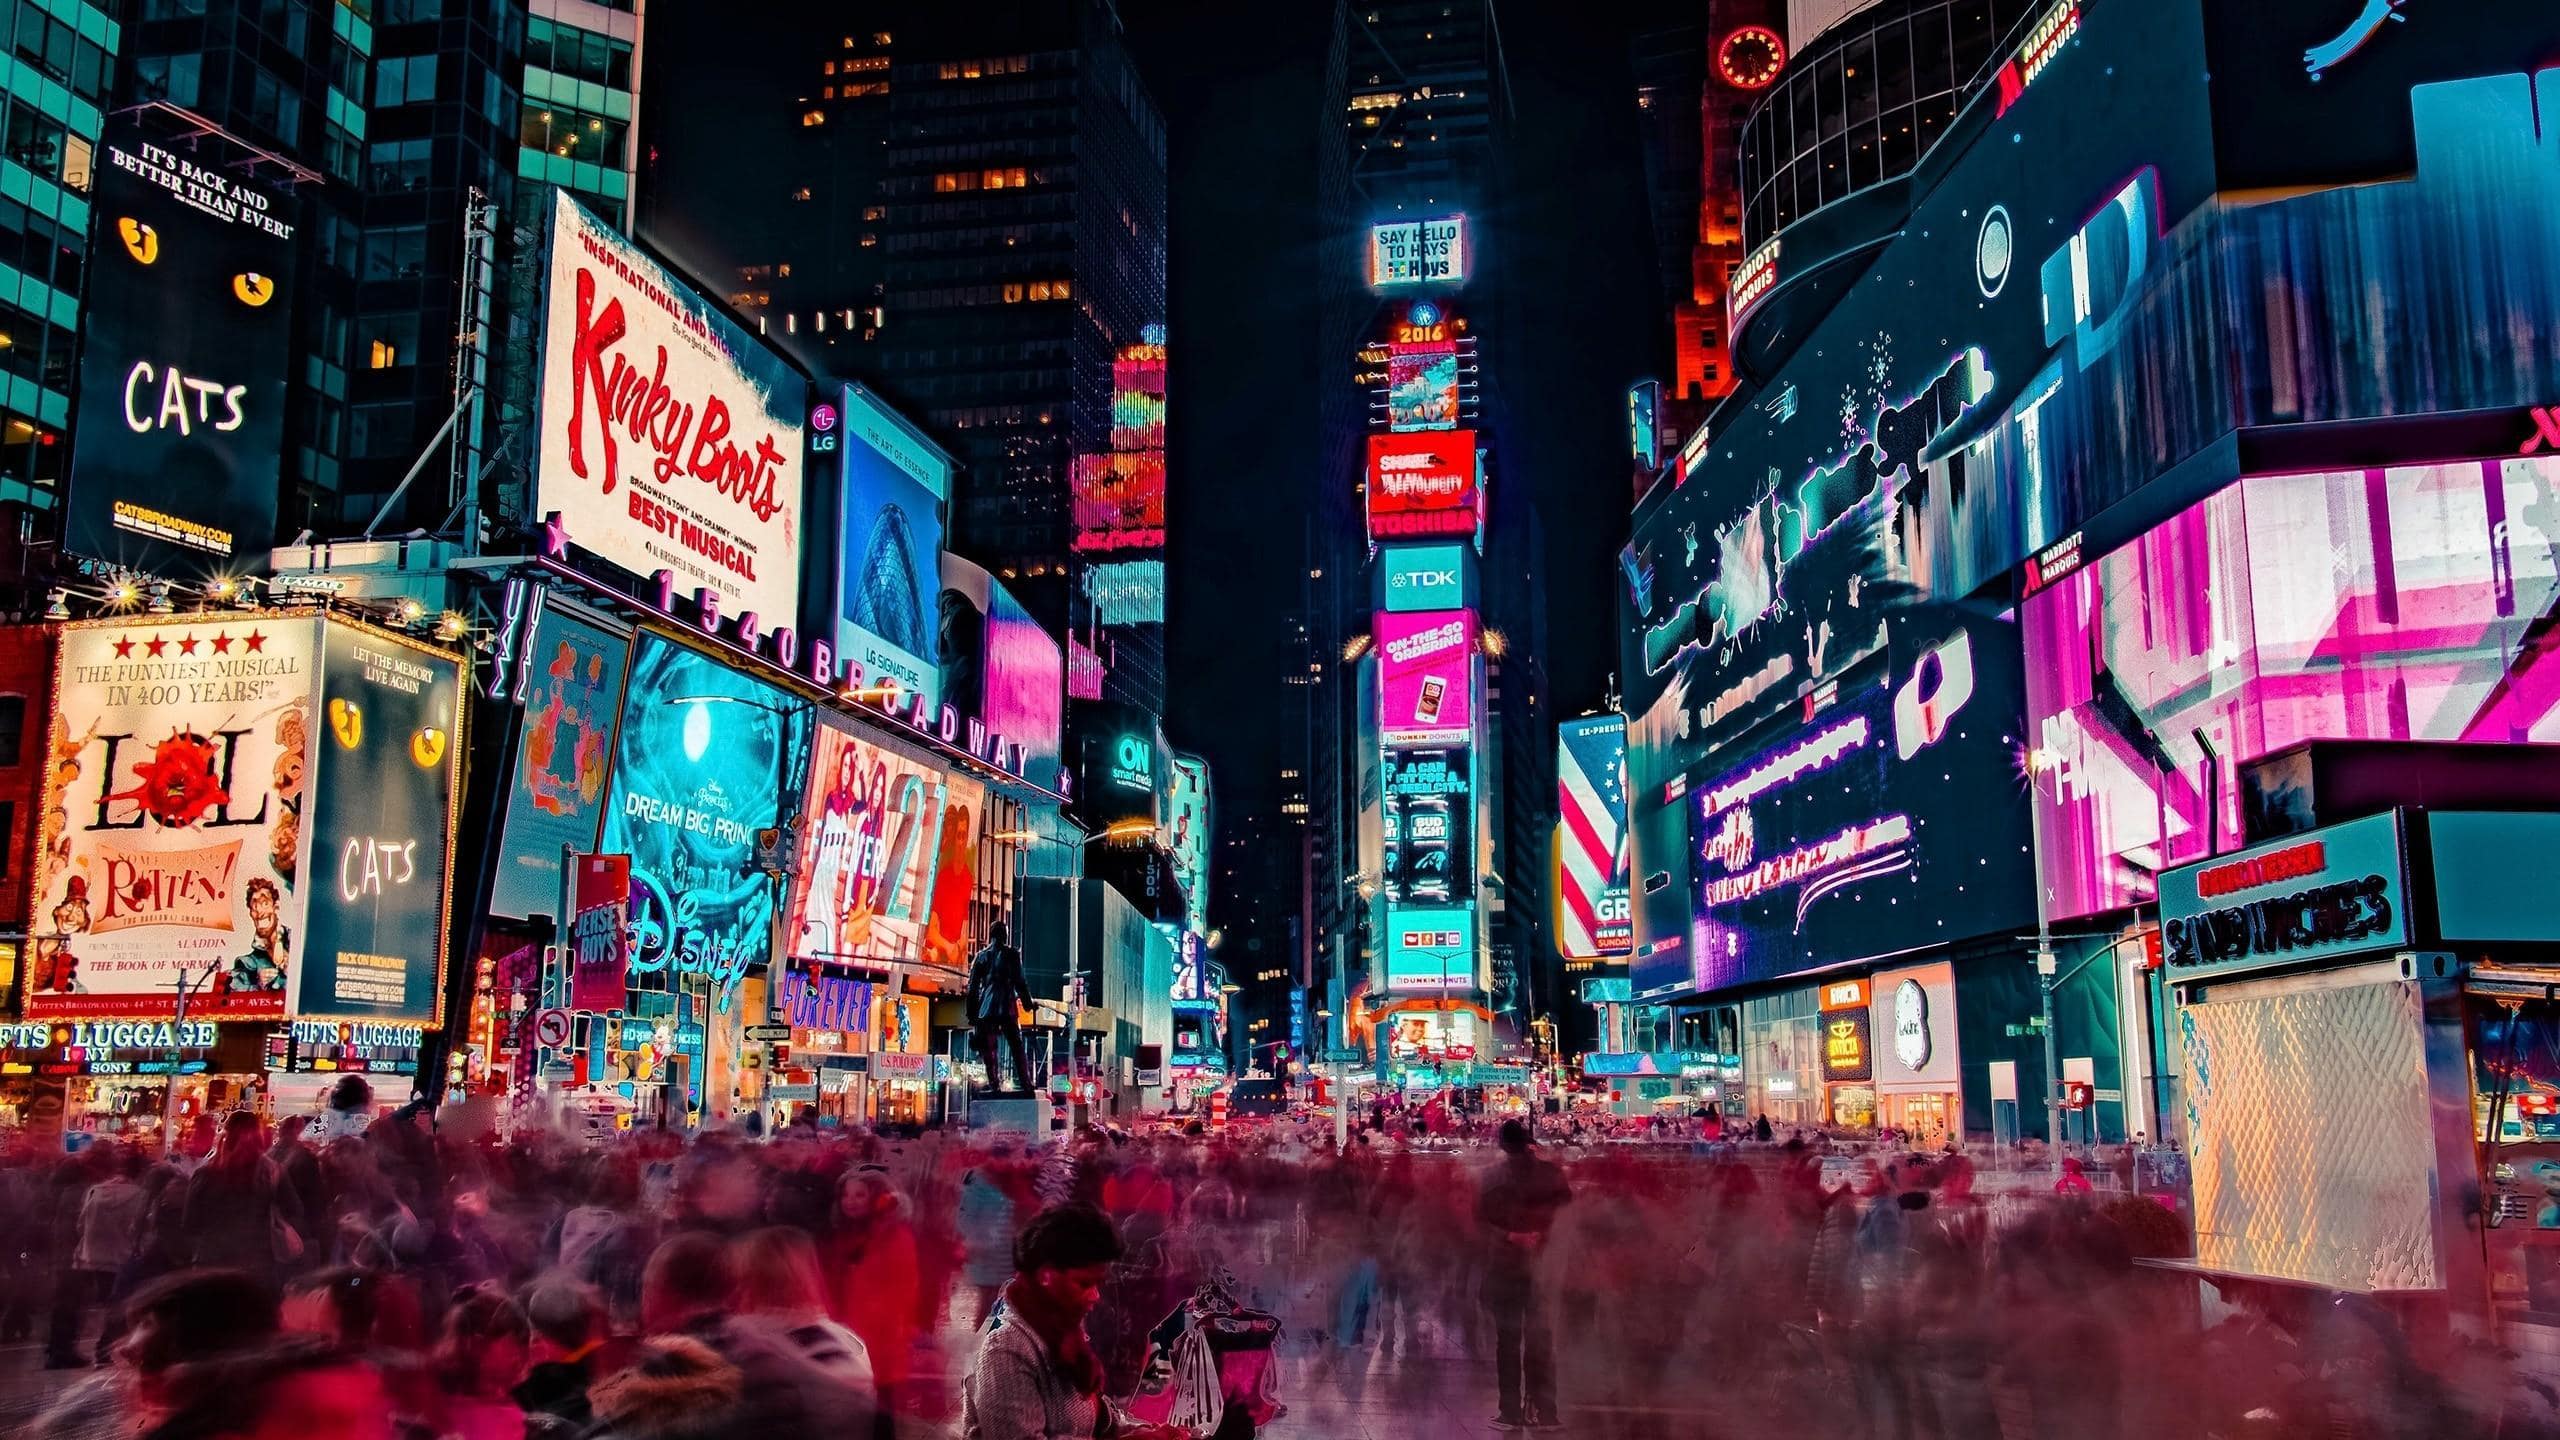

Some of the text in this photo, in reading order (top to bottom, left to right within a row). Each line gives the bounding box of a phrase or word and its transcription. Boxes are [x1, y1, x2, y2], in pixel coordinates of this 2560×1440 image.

[2025, 15, 2077, 87] MARQUIS
[142, 143, 268, 211] IT'S BACK AND
[187, 181, 237, 217] THAN
[1380, 226, 1456, 245] SAY HELLO
[1387, 242, 1448, 258] TO HAYS
[1733, 240, 1780, 297] MARRIOTT
[1734, 268, 1773, 317] MARQUIS
[683, 311, 707, 338] AND
[1400, 326, 1444, 343] 2016
[1390, 342, 1455, 355] TOSHIBA
[125, 362, 247, 436] CATS
[568, 268, 786, 523] Kinky Boots
[813, 436, 834, 451] LG
[867, 427, 930, 483] THE ART OF ESSENCE
[114, 501, 232, 544] CATSBROADWAY.COM
[672, 500, 689, 515] TONY
[691, 511, 703, 523] AND
[1373, 510, 1475, 534] TOSHIBA
[629, 490, 756, 582] BEST MUSICAL
[2041, 531, 2083, 566] MARRIOTT
[1406, 570, 1456, 586] TDK
[2042, 551, 2079, 581] MARQUIS
[1386, 621, 1464, 653] ON-THE-GO
[1392, 632, 1464, 663] ORDERING
[76, 657, 300, 683] THE FUNNIEST MUSICAL
[353, 647, 434, 683] LET THE MEMORY
[650, 568, 1030, 777] 1540 BROADWAY
[866, 647, 919, 688] LG SIGNATURE
[366, 667, 420, 694] LIVE AGAIN
[106, 686, 130, 706] IN
[137, 685, 180, 705] 400
[1119, 739, 1149, 774] ON
[1406, 762, 1446, 773] A CAN
[1113, 768, 1135, 781] smart
[1396, 771, 1457, 784] FIT FOR A
[1388, 783, 1431, 795] QUEEN
[625, 792, 682, 827] DREAM
[685, 809, 713, 838] BIG,
[1415, 817, 1443, 827] BUD
[1412, 827, 1445, 837] LIGHT
[873, 773, 947, 925] 21
[340, 837, 416, 901] CATS
[176, 939, 226, 950] ALADDIN
[581, 931, 617, 964] BOYS
[89, 962, 113, 971] THE
[116, 961, 150, 970] BOOK
[152, 961, 166, 970] OF
[247, 998, 271, 1007] AVES
[782, 970, 872, 1032] FOREVER
[72, 1022, 217, 1048] LUGGAGE
[292, 1022, 423, 1048] GIFTS LUGGAGE
[84, 1047, 109, 1061] NY
[356, 1046, 373, 1059] NY
[892, 1055, 909, 1068] POLO
[90, 1063, 132, 1073] SONY
[369, 1061, 395, 1071] SONY
